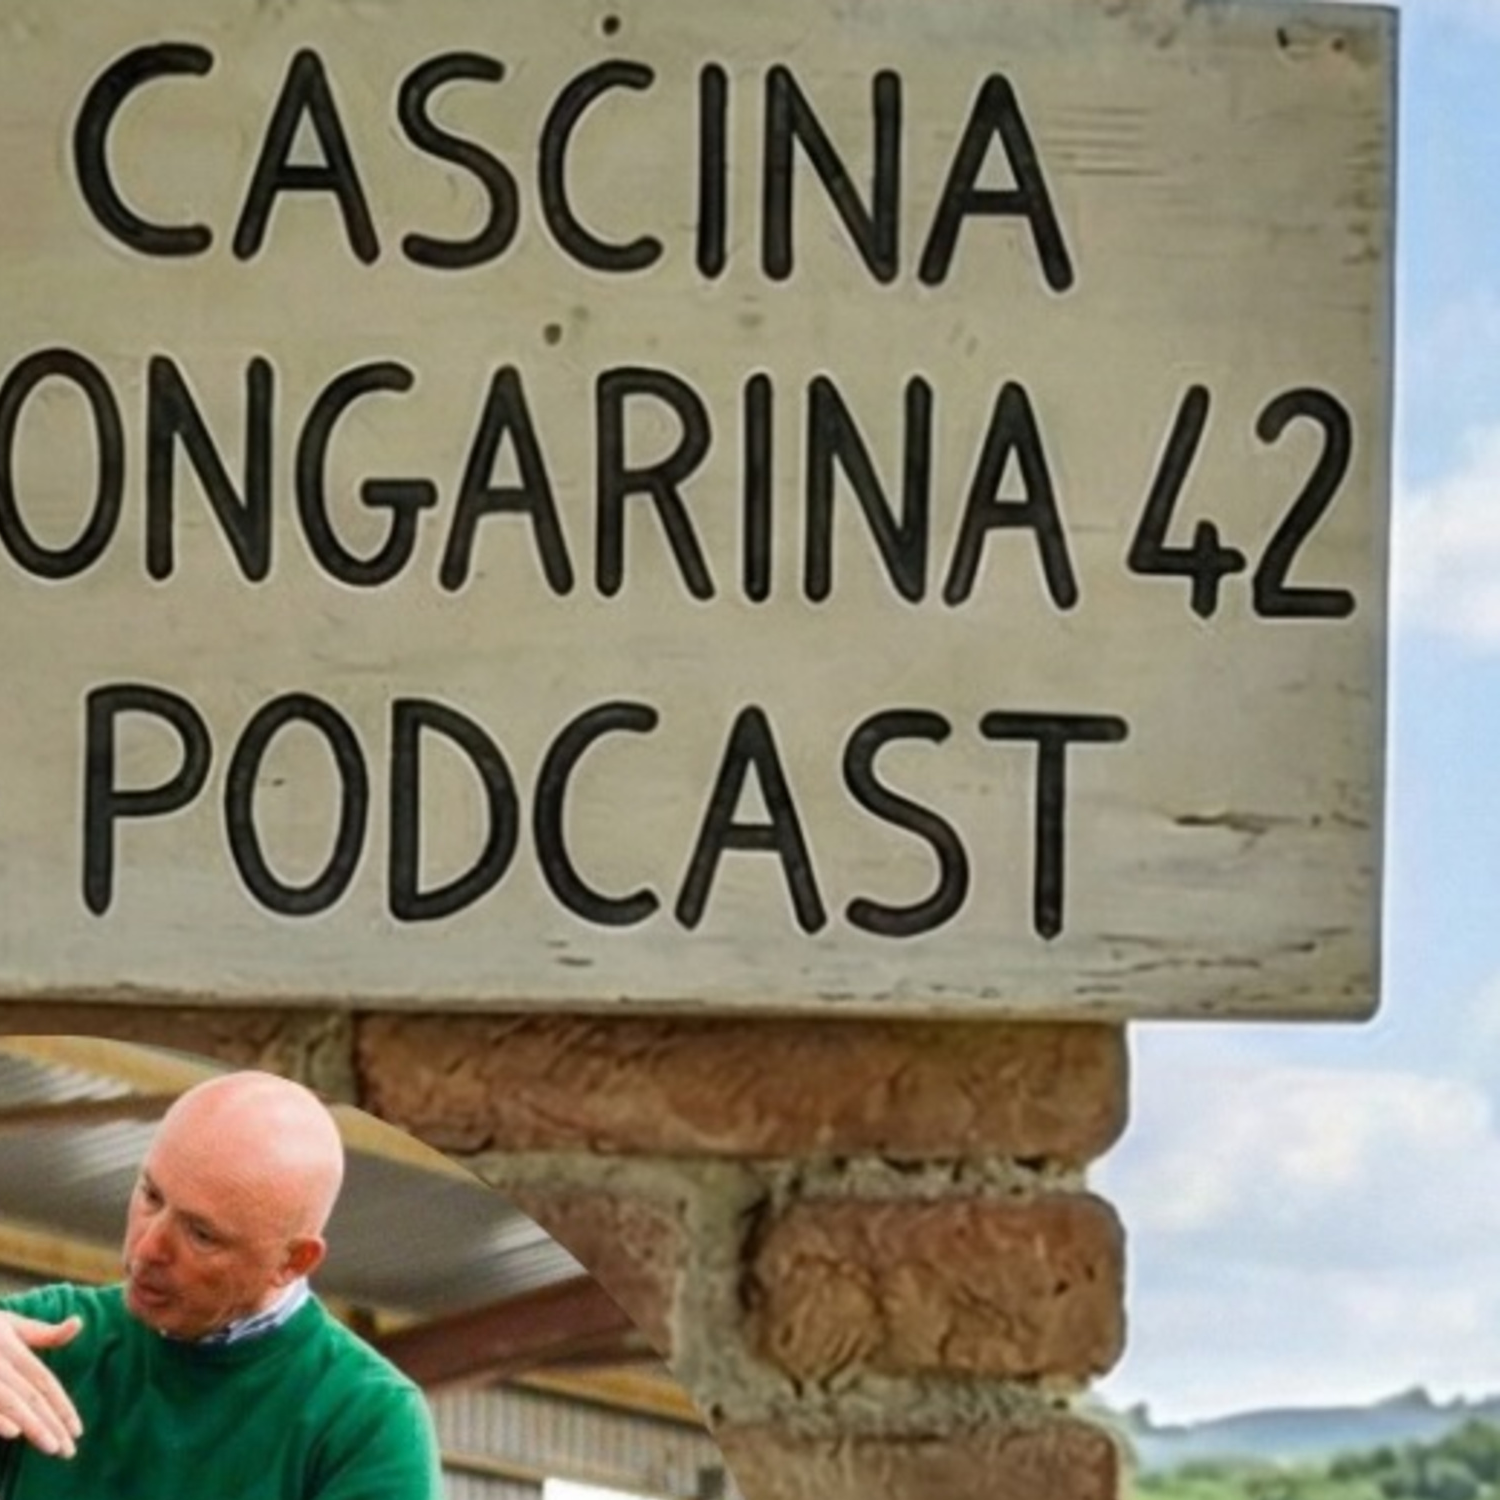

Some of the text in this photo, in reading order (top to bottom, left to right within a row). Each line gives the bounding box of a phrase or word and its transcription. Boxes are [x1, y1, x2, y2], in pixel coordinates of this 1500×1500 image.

[72, 40, 1076, 294] CASCINA
[1125, 383, 1358, 621] 42
[80, 682, 1130, 943] PODCAST
